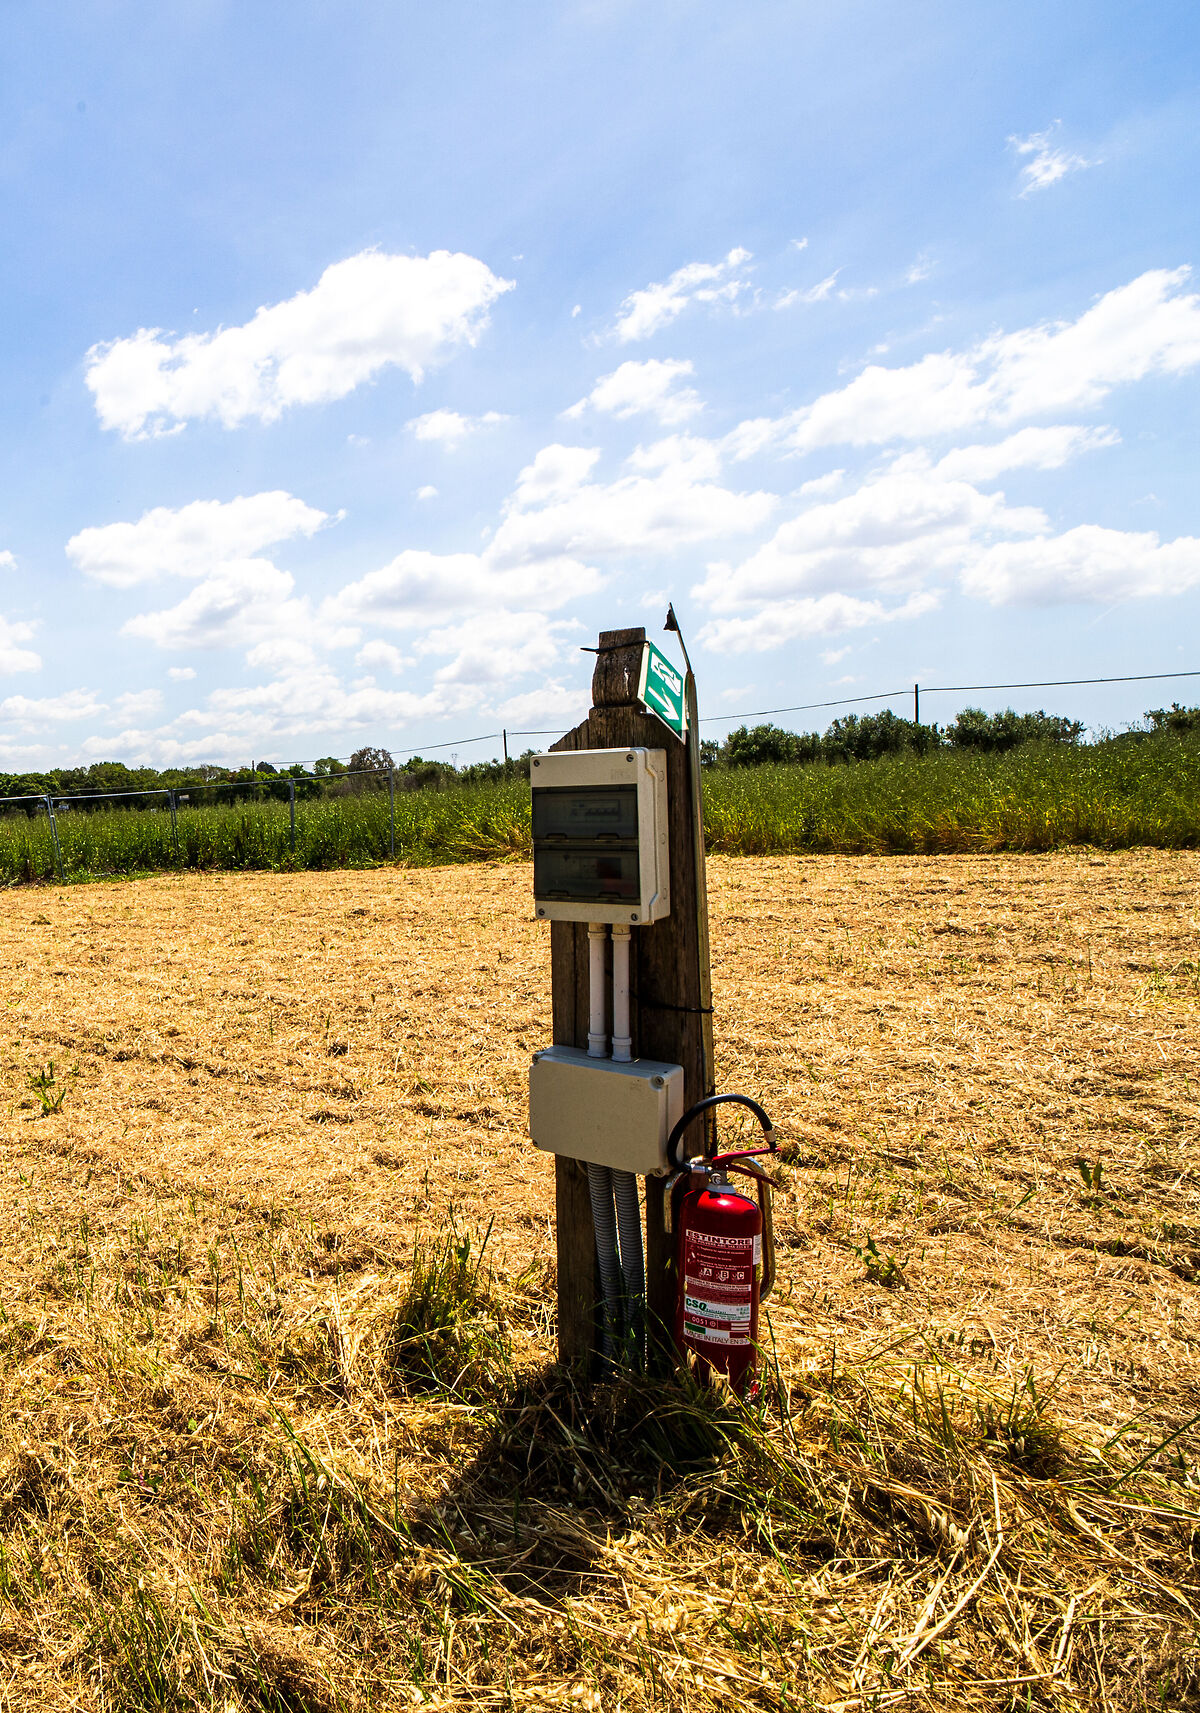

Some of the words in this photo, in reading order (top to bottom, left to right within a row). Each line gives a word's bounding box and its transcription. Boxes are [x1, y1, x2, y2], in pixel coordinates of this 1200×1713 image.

[687, 1231, 751, 1245] ESTINTORE
[686, 1298, 707, 1311] CSQ
[692, 1316, 708, 1325] 0051
[686, 1330, 703, 1339] MADE
